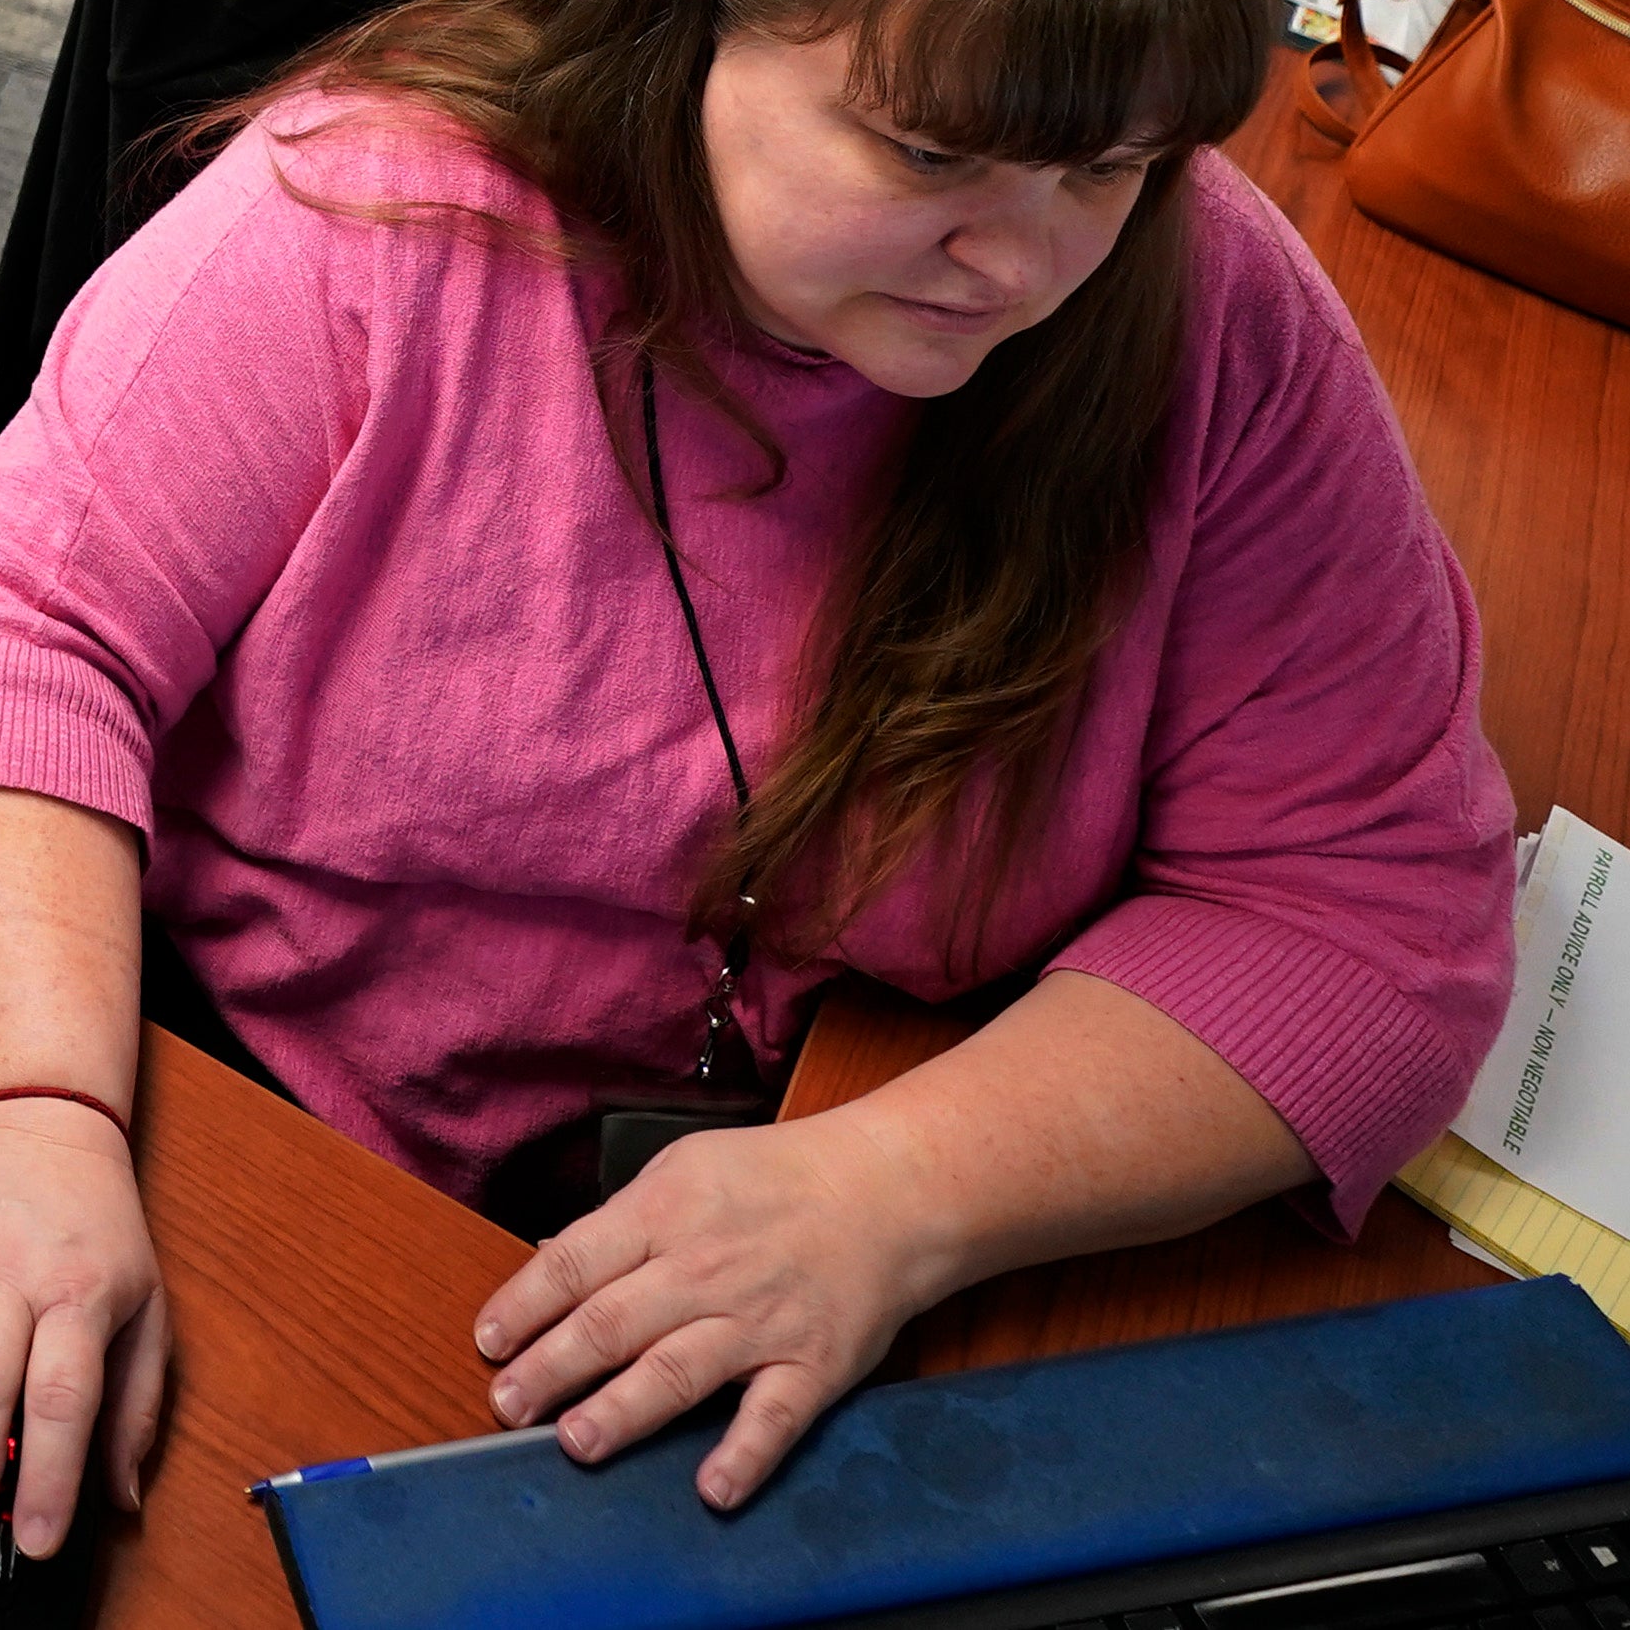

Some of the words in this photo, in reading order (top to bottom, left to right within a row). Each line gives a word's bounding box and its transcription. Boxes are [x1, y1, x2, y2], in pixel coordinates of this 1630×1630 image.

[1579, 846, 1613, 910] PAYROLL
[1560, 909, 1592, 965] ADVICE
[1547, 964, 1574, 1009] ONLY
[1531, 1023, 1556, 1058] NON
[1501, 1058, 1545, 1156] NEGOTIABLE
